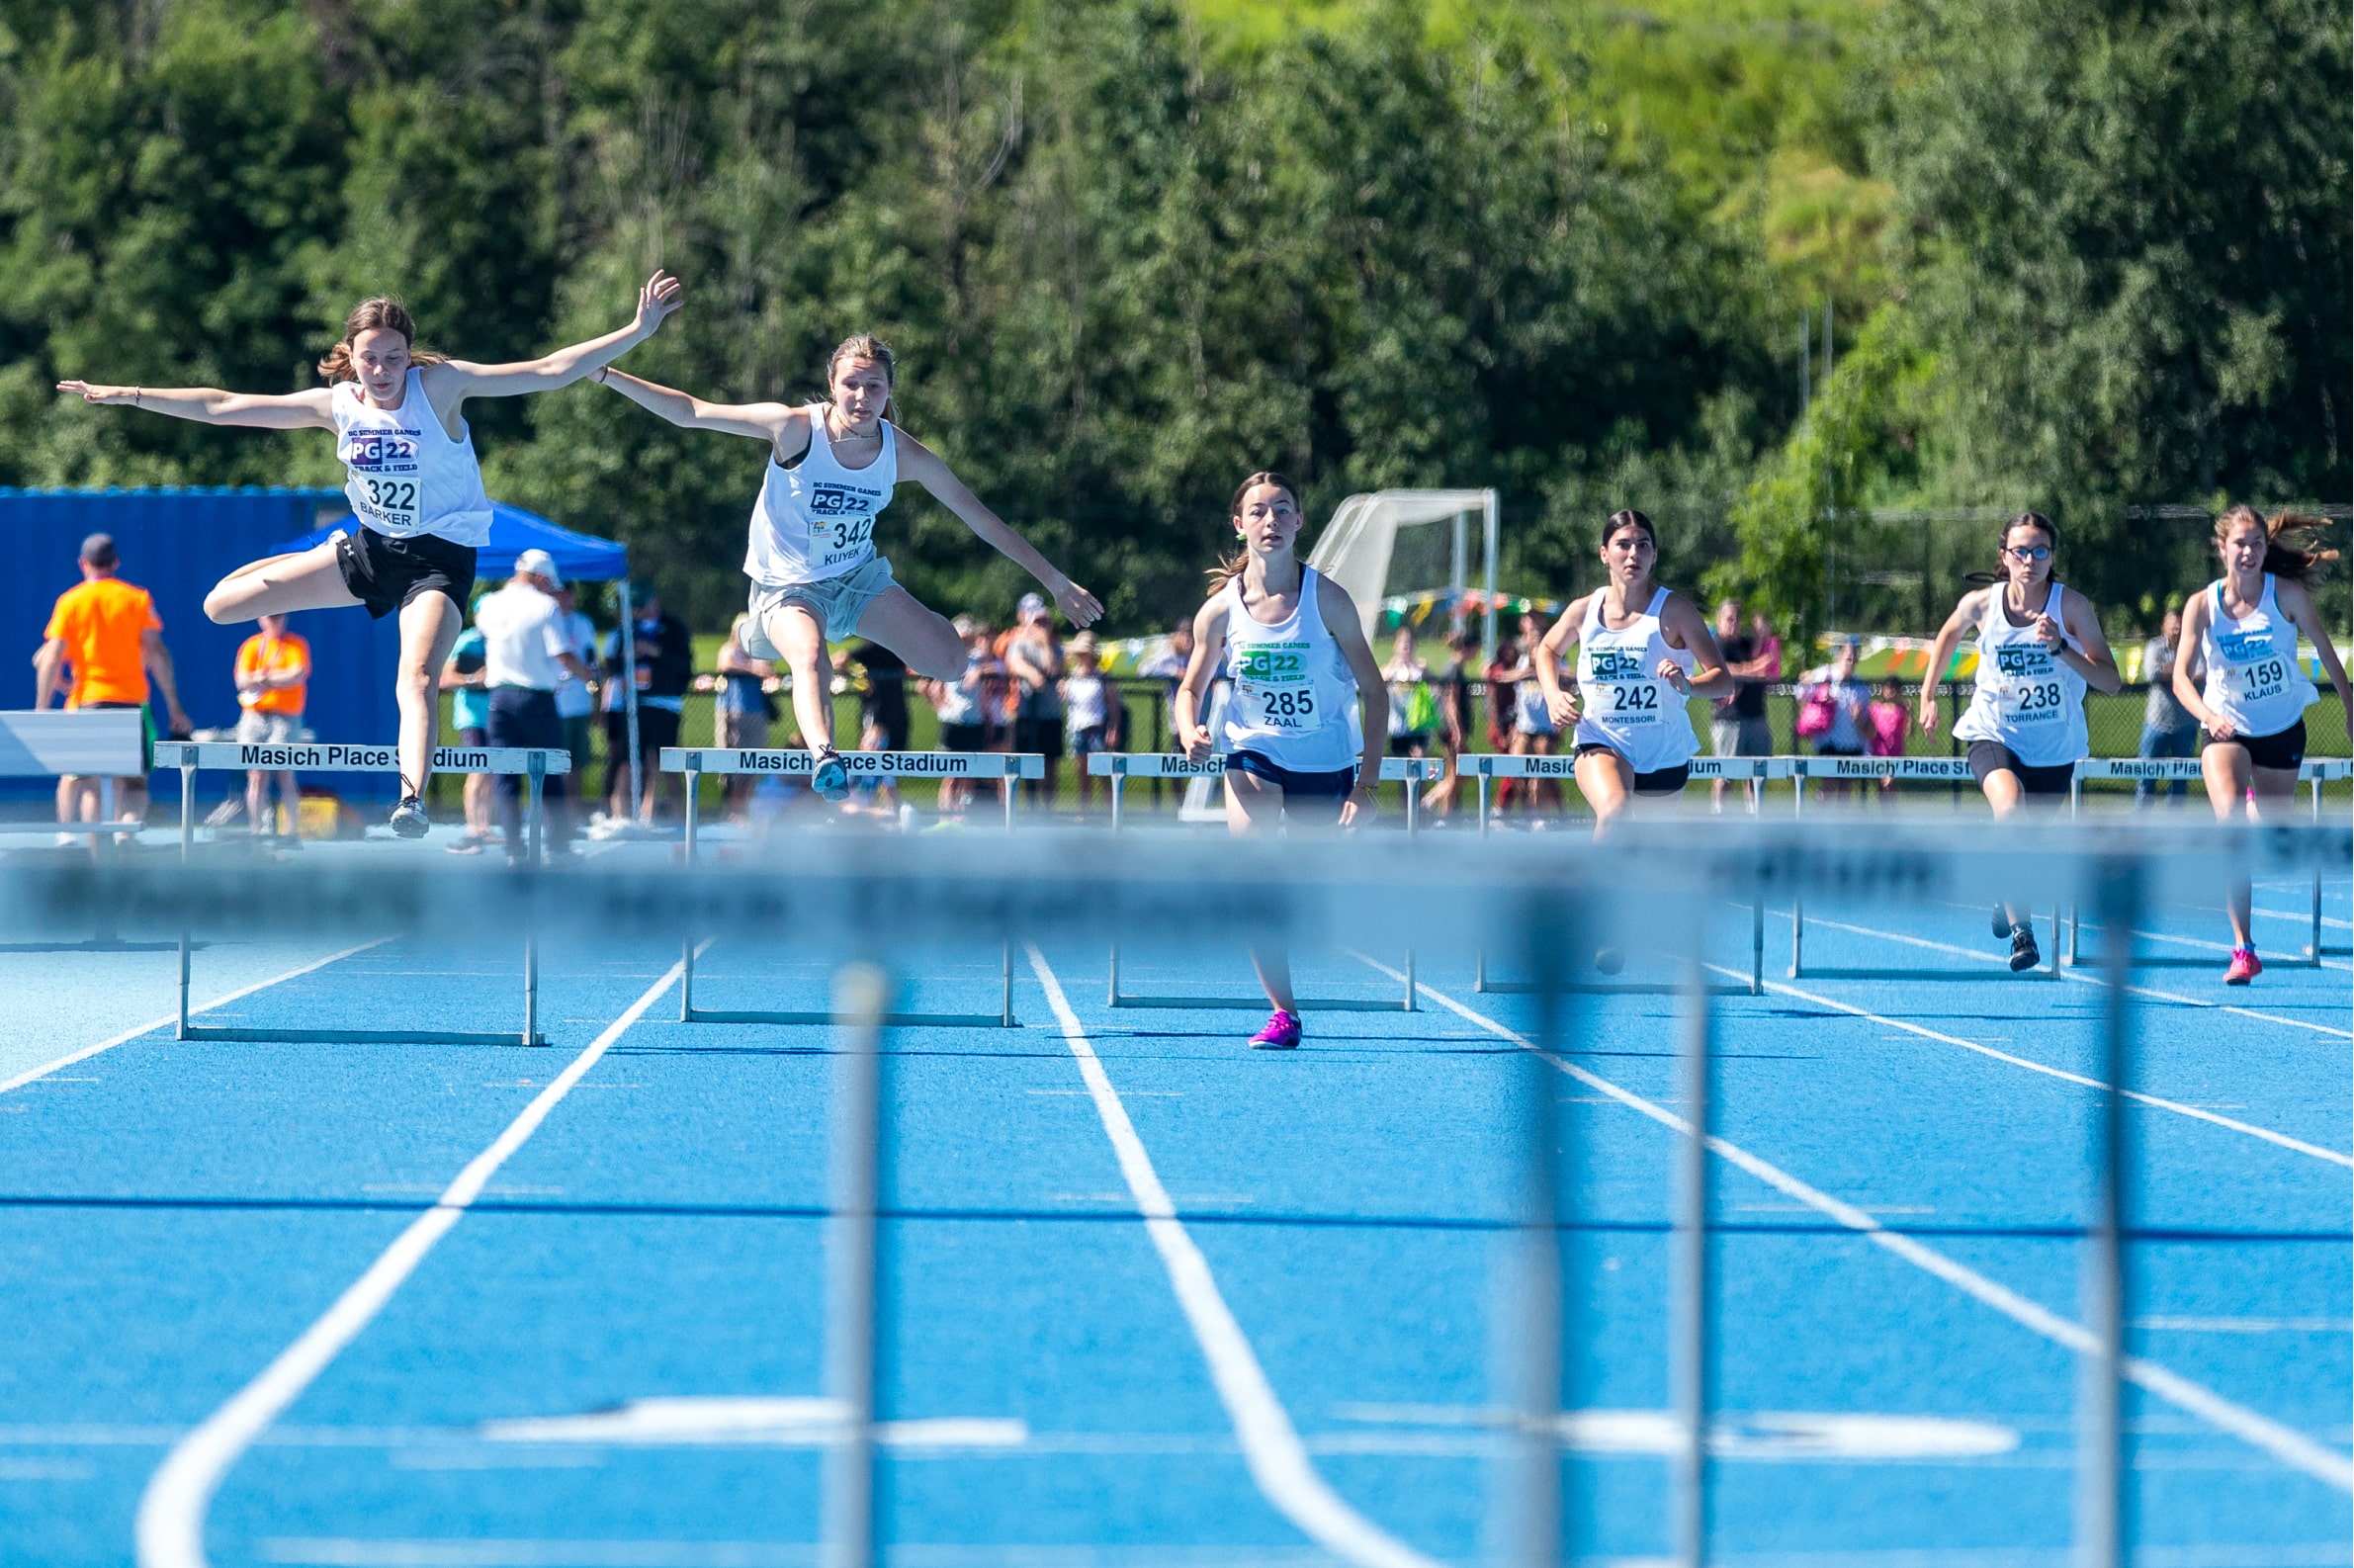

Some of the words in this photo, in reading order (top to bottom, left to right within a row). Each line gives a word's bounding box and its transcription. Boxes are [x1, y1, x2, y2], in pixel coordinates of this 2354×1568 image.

[352, 442, 381, 460] PG
[386, 442, 411, 459] 22
[368, 479, 415, 511] 322
[823, 482, 856, 492] SUMMER
[857, 487, 882, 496] GAMES
[813, 493, 841, 508] PG
[844, 496, 869, 512] 22
[360, 501, 411, 527] BARKER
[832, 518, 872, 550] 342
[825, 548, 859, 566] KUYEK
[2223, 643, 2245, 655] PG
[1240, 655, 1268, 671] PG
[1273, 654, 1299, 671] 22
[1592, 656, 1615, 671] PG
[1618, 656, 1639, 671] 22
[1999, 653, 2025, 667] PG
[2026, 653, 2049, 665] 22
[2244, 660, 2283, 688] 159
[1613, 685, 1658, 711] 242
[2018, 682, 2061, 711] 238
[2243, 683, 2282, 702] KLAUS
[1263, 689, 1314, 716] 285
[1264, 715, 1303, 728] ZAAL
[1602, 715, 1656, 724] MONTESSORI
[2005, 709, 2058, 724] TORRANCE
[241, 744, 320, 766] Masich
[328, 745, 390, 766] Place
[394, 746, 488, 768] dium
[740, 751, 813, 770] Masich
[843, 755, 877, 771] ace
[881, 752, 967, 772] Stadium
[1526, 757, 1575, 775] Masic
[1837, 758, 1896, 776] Masich
[1903, 759, 1949, 775] Place
[2110, 761, 2166, 777] Masich
